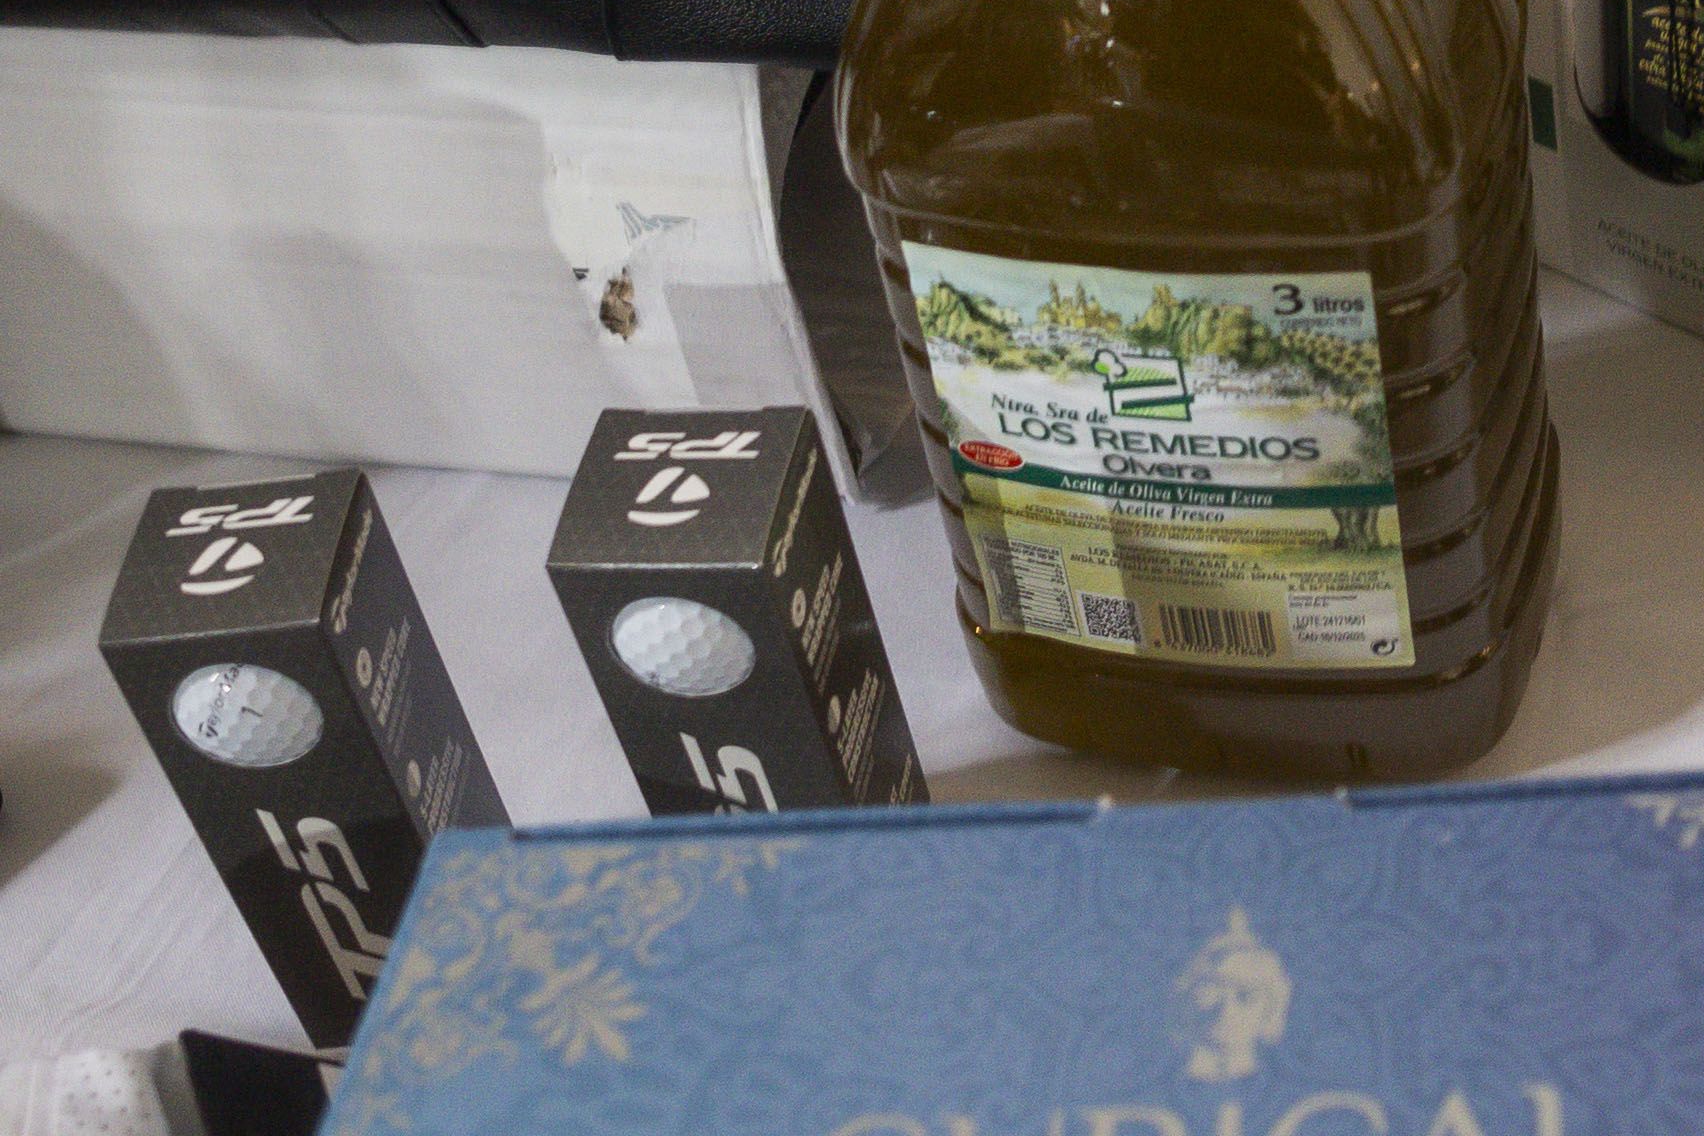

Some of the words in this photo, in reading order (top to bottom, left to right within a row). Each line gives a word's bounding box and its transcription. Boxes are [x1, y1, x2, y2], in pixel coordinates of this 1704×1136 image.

[1273, 283, 1304, 315] 3
[1313, 294, 1365, 314] litros
[991, 393, 1039, 415] Ntra.
[1047, 401, 1080, 422] Sra
[1086, 407, 1109, 425] de
[998, 412, 1077, 445] LOS
[1090, 426, 1320, 462] REMEDIOS
[1102, 452, 1212, 481] Olvera
[1060, 474, 1104, 495] Aceite
[1108, 480, 1125, 496] de
[1129, 481, 1171, 501] Oliva
[1177, 487, 1226, 507] Virgen
[1230, 489, 1273, 506] Extra
[1111, 498, 1165, 519] Aceite
[1170, 505, 1225, 523] Fresco
